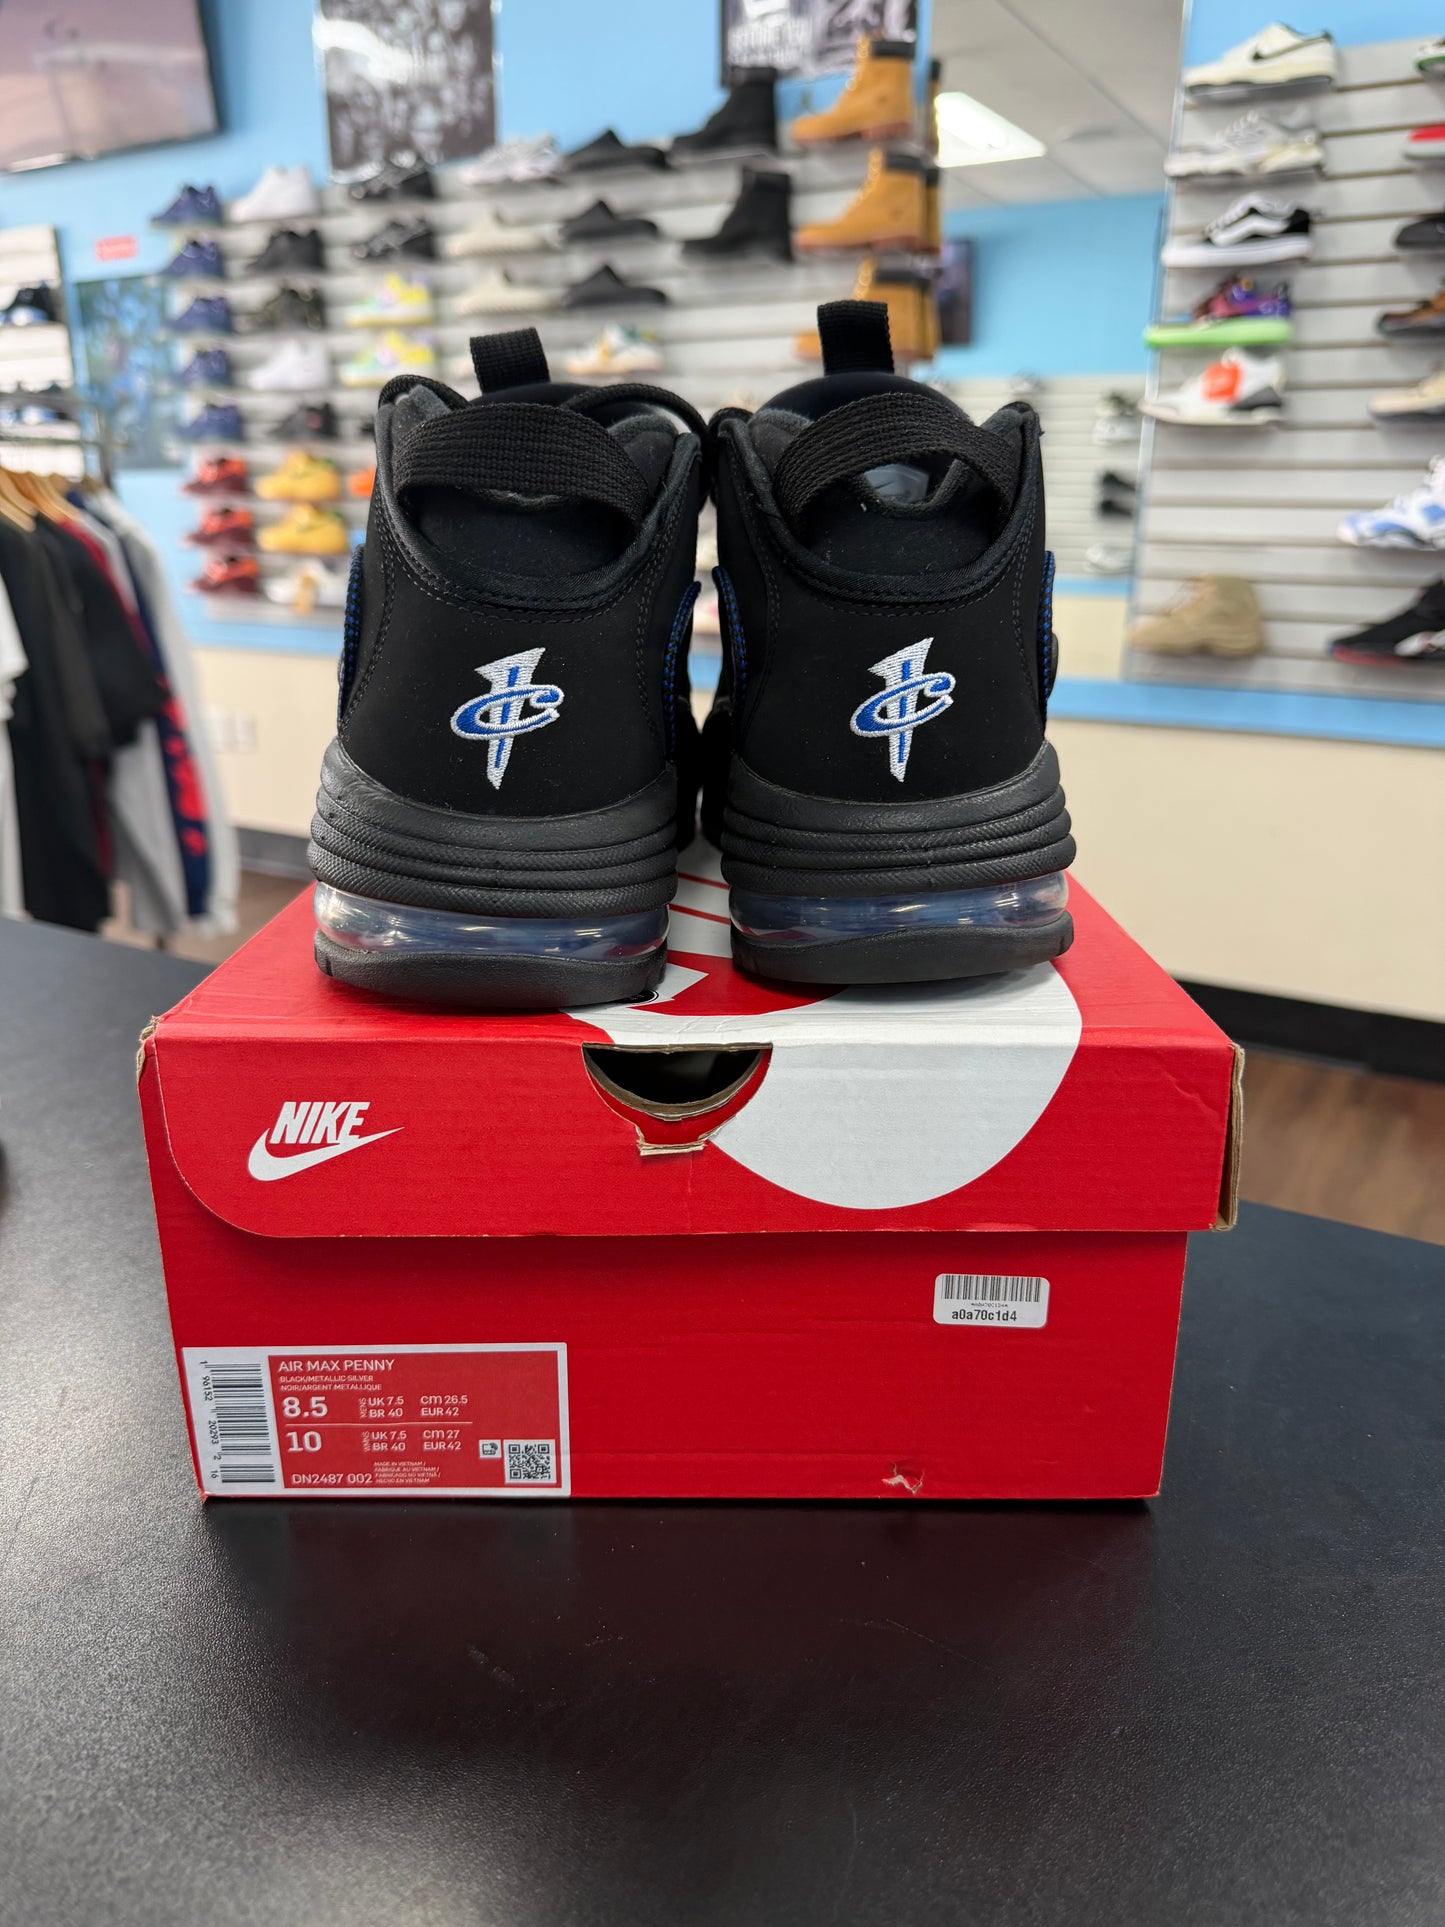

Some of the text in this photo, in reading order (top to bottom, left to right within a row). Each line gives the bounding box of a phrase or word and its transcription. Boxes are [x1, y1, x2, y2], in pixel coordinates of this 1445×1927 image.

[269, 1101, 371, 1145] NIKE
[951, 1308, 1017, 1322] a0a70c1d4
[279, 1359, 395, 1372] AIR MAX PENNY
[368, 1396, 405, 1406] UK 7.5
[444, 1395, 468, 1405] 26.5
[283, 1396, 329, 1418] 8.5
[421, 1407, 460, 1416] EUR 42
[369, 1408, 403, 1418] BR 40
[371, 1430, 407, 1440] UK 7.5
[446, 1429, 461, 1439] 27
[286, 1431, 322, 1453] 10
[372, 1442, 406, 1452] BR 40
[423, 1441, 462, 1451] EUR 42
[291, 1473, 373, 1484] DN2487 002
